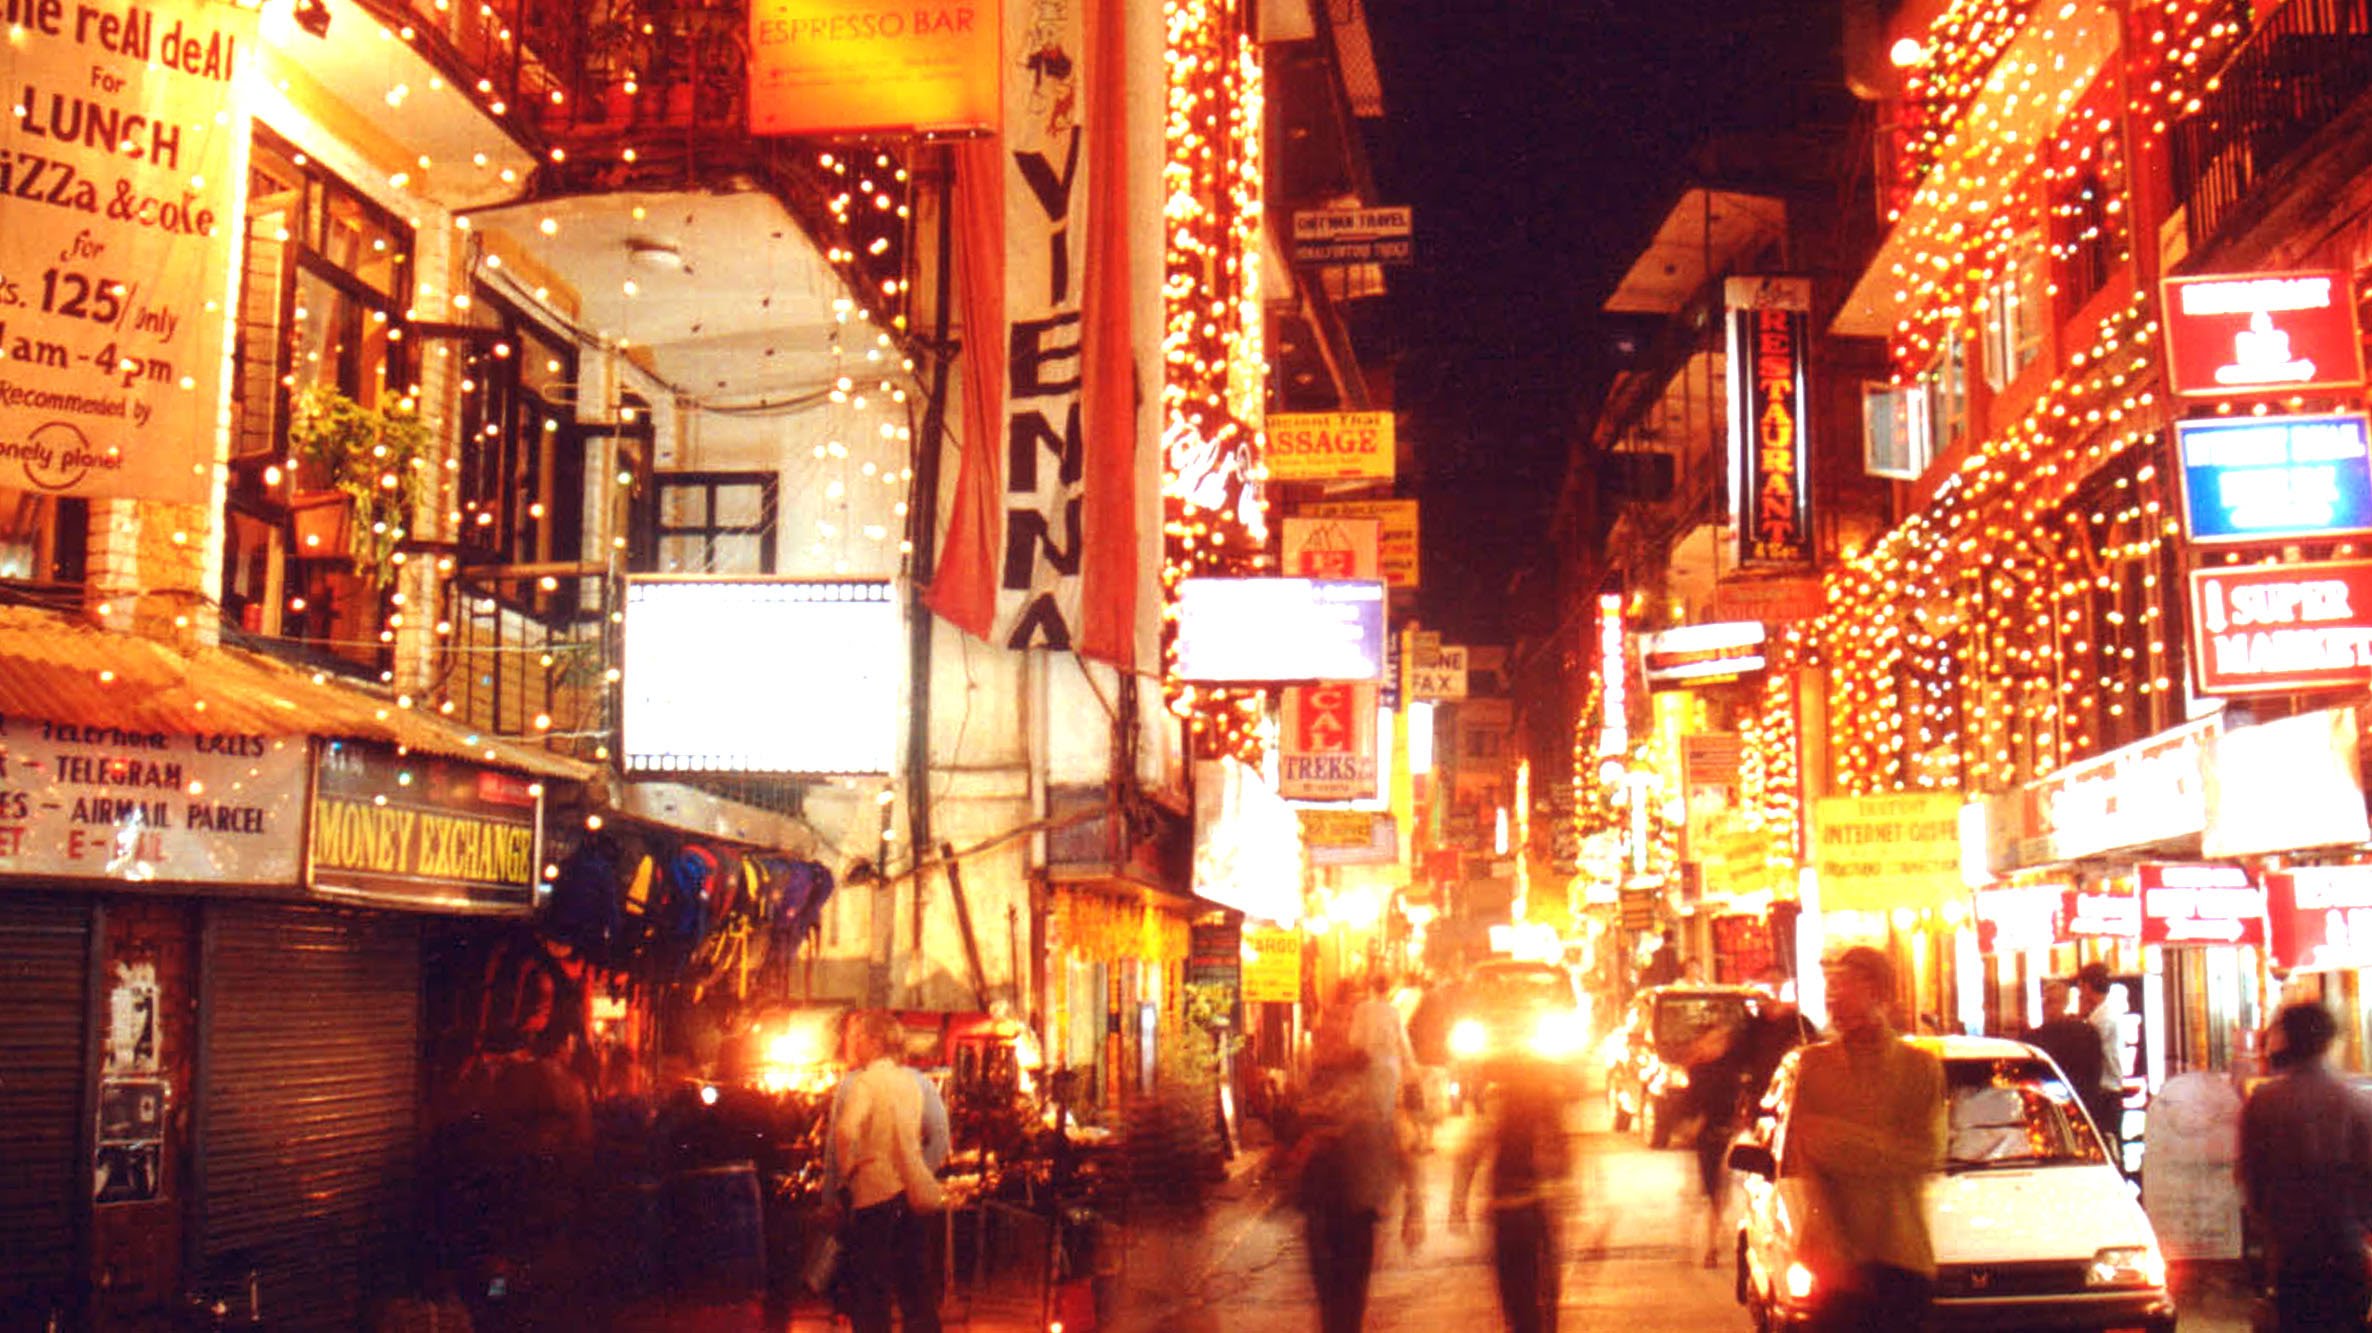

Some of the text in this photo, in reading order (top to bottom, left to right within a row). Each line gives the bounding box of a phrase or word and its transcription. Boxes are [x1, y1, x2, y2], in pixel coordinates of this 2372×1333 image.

[759, 7, 975, 45] ESPRESSO BAR
[21, 85, 180, 171] LUNCH
[0, 150, 98, 213] iZZa
[133, 396, 152, 427] by
[1757, 309, 1794, 546] RESTAURANT
[1263, 429, 1377, 455] ASSAGE
[2231, 580, 2353, 625] SUPER
[2213, 626, 2372, 675] MARKET
[56, 755, 183, 791] TELEGRAM
[1285, 756, 1358, 780] TREKS
[70, 797, 171, 828] AIRMAIL
[186, 804, 265, 835] PARCEL
[1823, 823, 1902, 845] INTERNET
[315, 799, 532, 883] MONEY EXCHANGE
